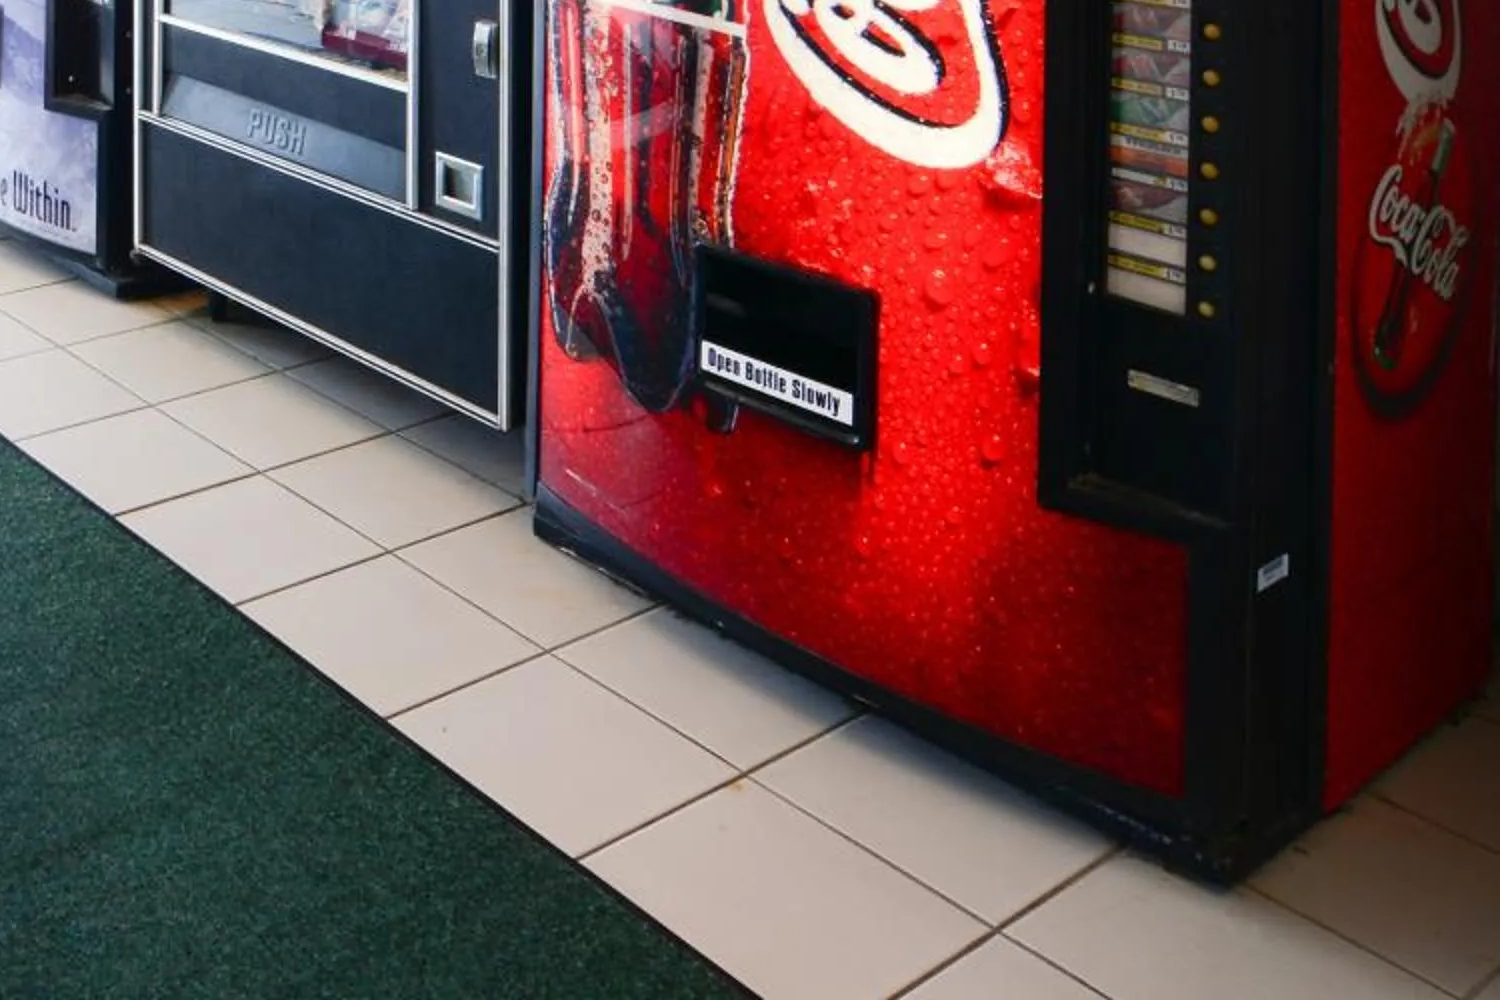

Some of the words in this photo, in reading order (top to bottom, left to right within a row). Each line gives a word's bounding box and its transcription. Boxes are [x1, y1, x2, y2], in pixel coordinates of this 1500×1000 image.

[247, 108, 307, 156] PUSH
[1368, 164, 1471, 302] Coca-Cola
[707, 347, 741, 377] Open
[745, 360, 788, 394] Bottle
[791, 378, 841, 417] Slowly
